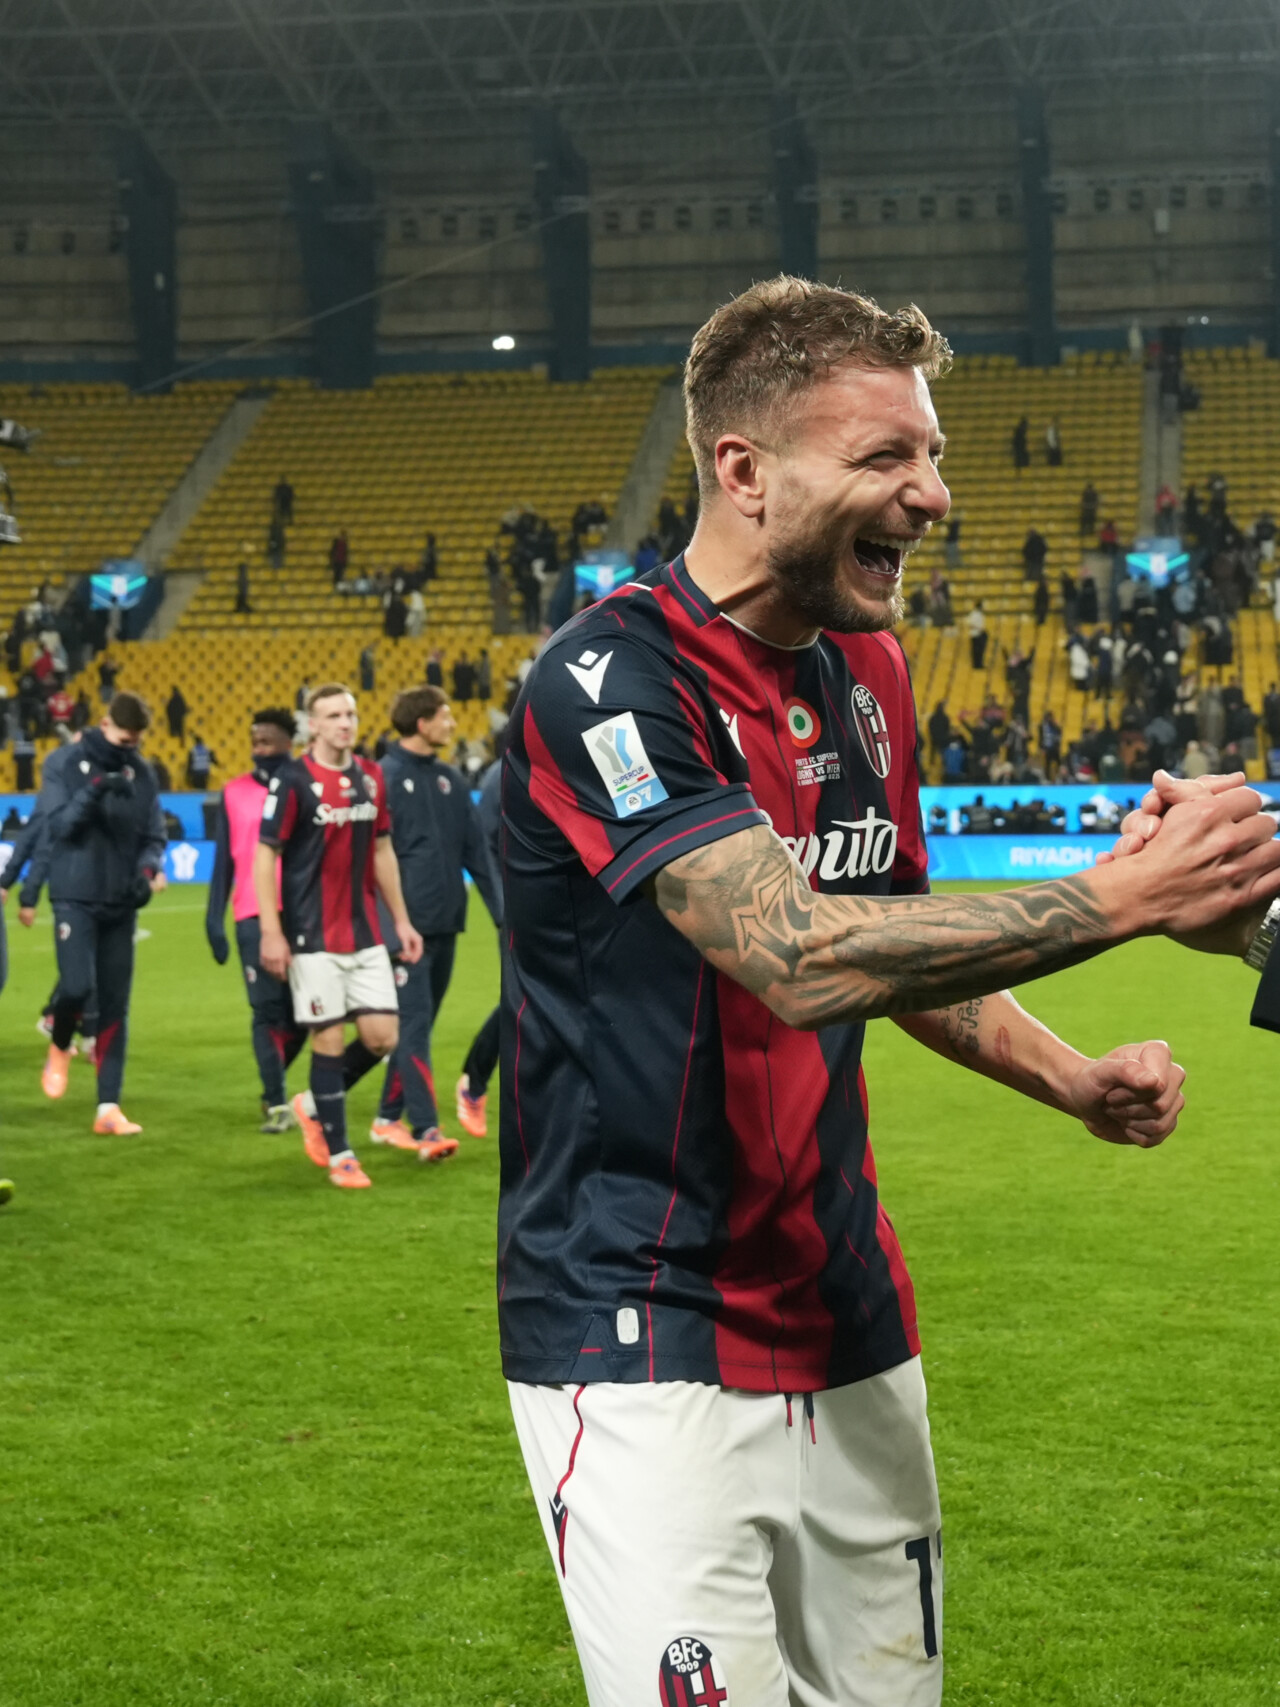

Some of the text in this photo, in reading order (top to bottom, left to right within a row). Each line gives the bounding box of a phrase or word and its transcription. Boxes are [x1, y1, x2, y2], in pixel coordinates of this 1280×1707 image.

[855, 688, 873, 708] BFC
[808, 756, 817, 764] FC
[612, 765, 645, 787] SUPERCUP
[815, 766, 826, 775] VS
[1010, 846, 1094, 867] RIYADH
[905, 1529, 941, 1659] 1
[667, 1639, 704, 1666] BFC
[675, 1660, 700, 1673] 1909
